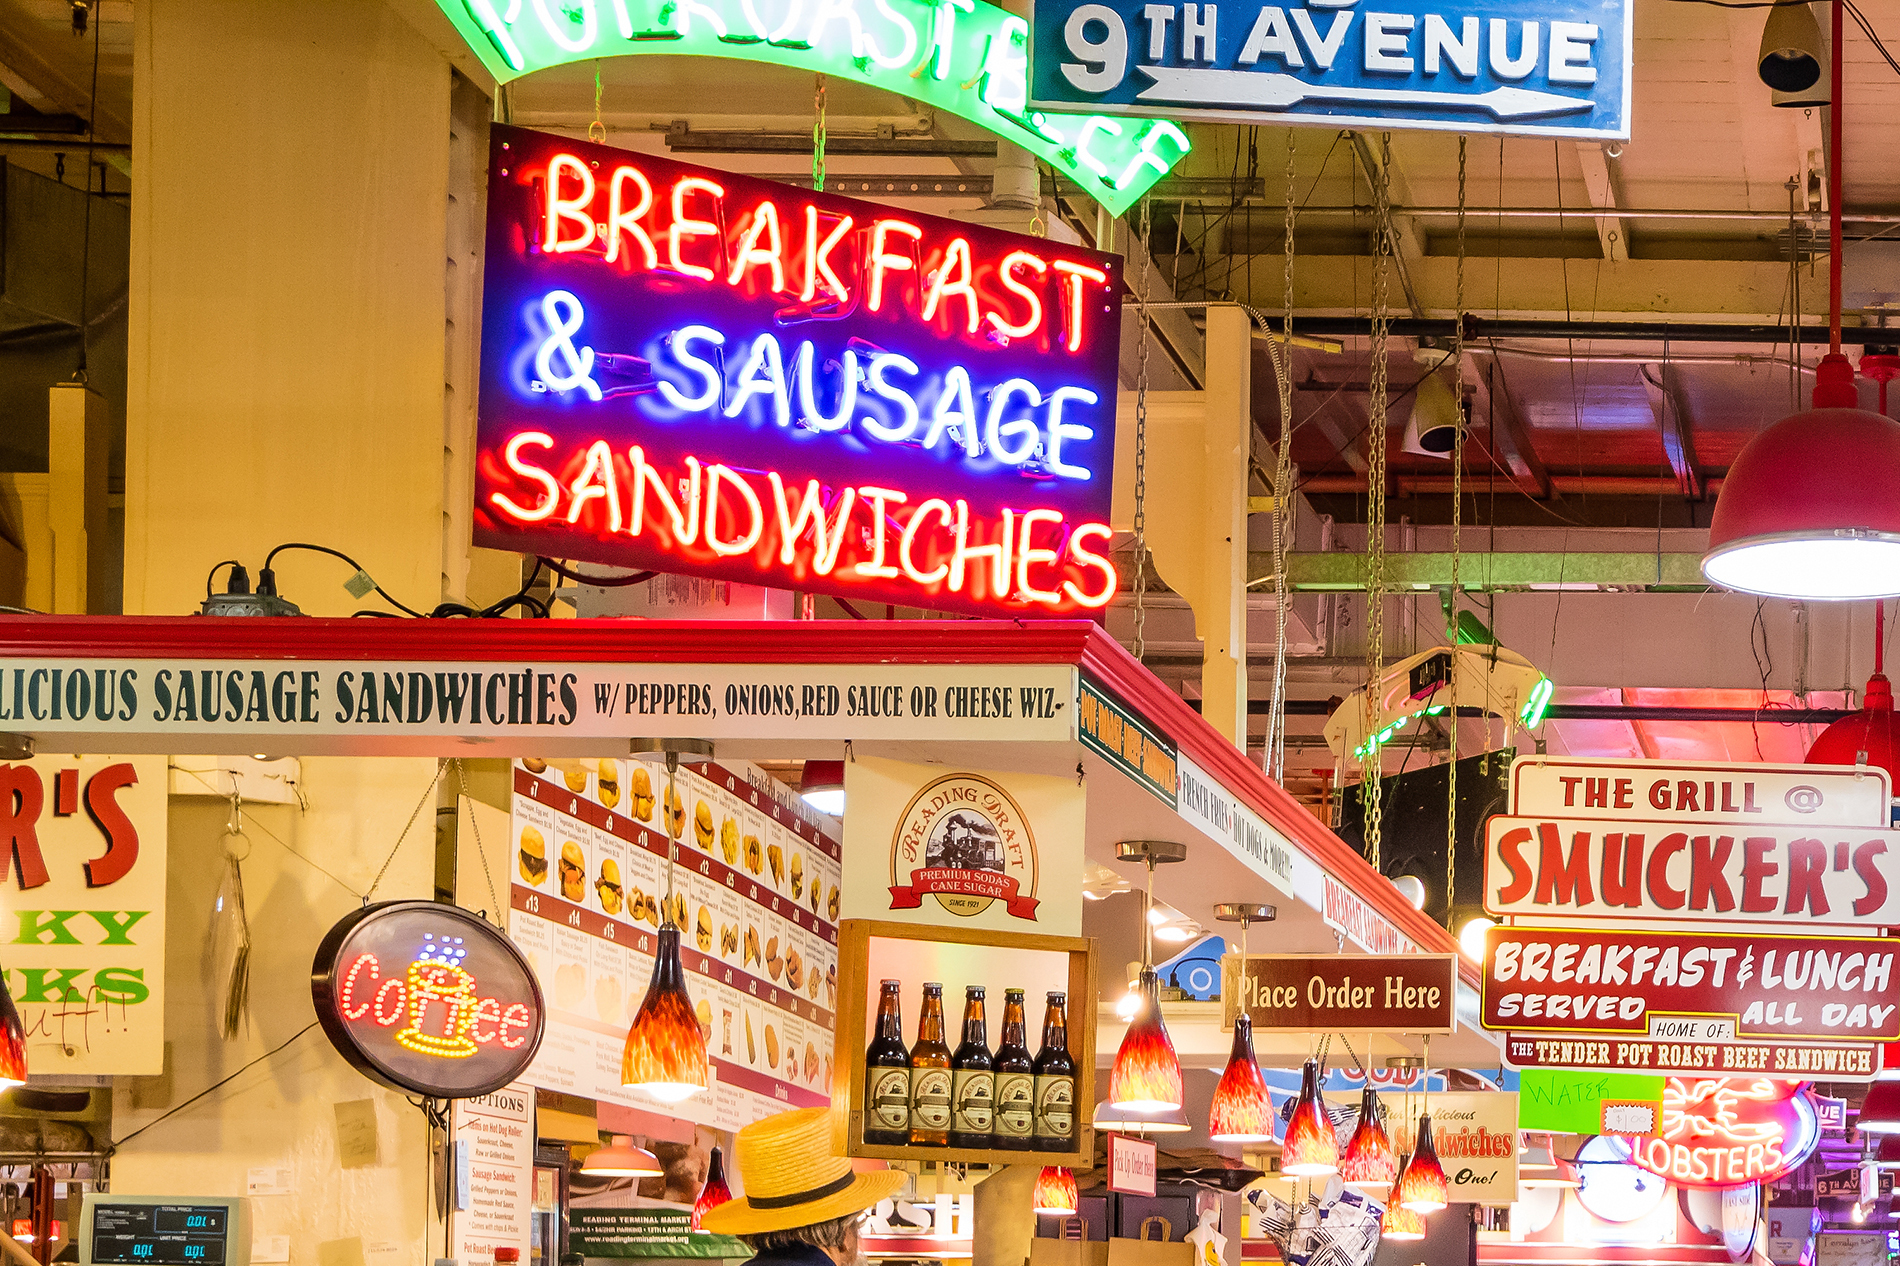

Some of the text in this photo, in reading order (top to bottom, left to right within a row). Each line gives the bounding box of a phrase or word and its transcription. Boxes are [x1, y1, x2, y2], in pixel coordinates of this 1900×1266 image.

[1060, 3, 1216, 93] 9TH
[1238, 5, 1598, 84] AVENUE
[542, 154, 1106, 352] BREAKFAST
[536, 289, 1098, 481] & SAUSAGE
[492, 432, 1118, 607] SANDWICHES
[153, 669, 320, 723] SAUSAGE
[336, 670, 577, 726] SANDWICHES
[594, 682, 620, 718] W/
[625, 684, 718, 719] PEPPERS,
[847, 685, 904, 718] SAUCE
[911, 686, 938, 717] OR
[944, 686, 1013, 718] CHEESE
[1558, 776, 1824, 814] THE GRILL @
[919, 869, 1011, 888] PREMIUM SODAS
[930, 881, 1003, 897] CANE SUGAR
[1496, 823, 1889, 917] SMUCKER'S
[1494, 941, 1737, 988] BREAKFAST
[1760, 948, 1894, 992] LUNCH
[341, 953, 531, 1049] Coffee
[1236, 975, 1441, 1009] Place Order Here
[1497, 993, 1646, 1021] SERVED
[1741, 1001, 1895, 1028] ALL DAY
[1655, 1022, 1730, 1039] HOME OF:
[1511, 1042, 1871, 1072] THE TENDER POT ROAST BEEF SANDWICH
[1632, 1135, 1785, 1181] LOBSTERS
